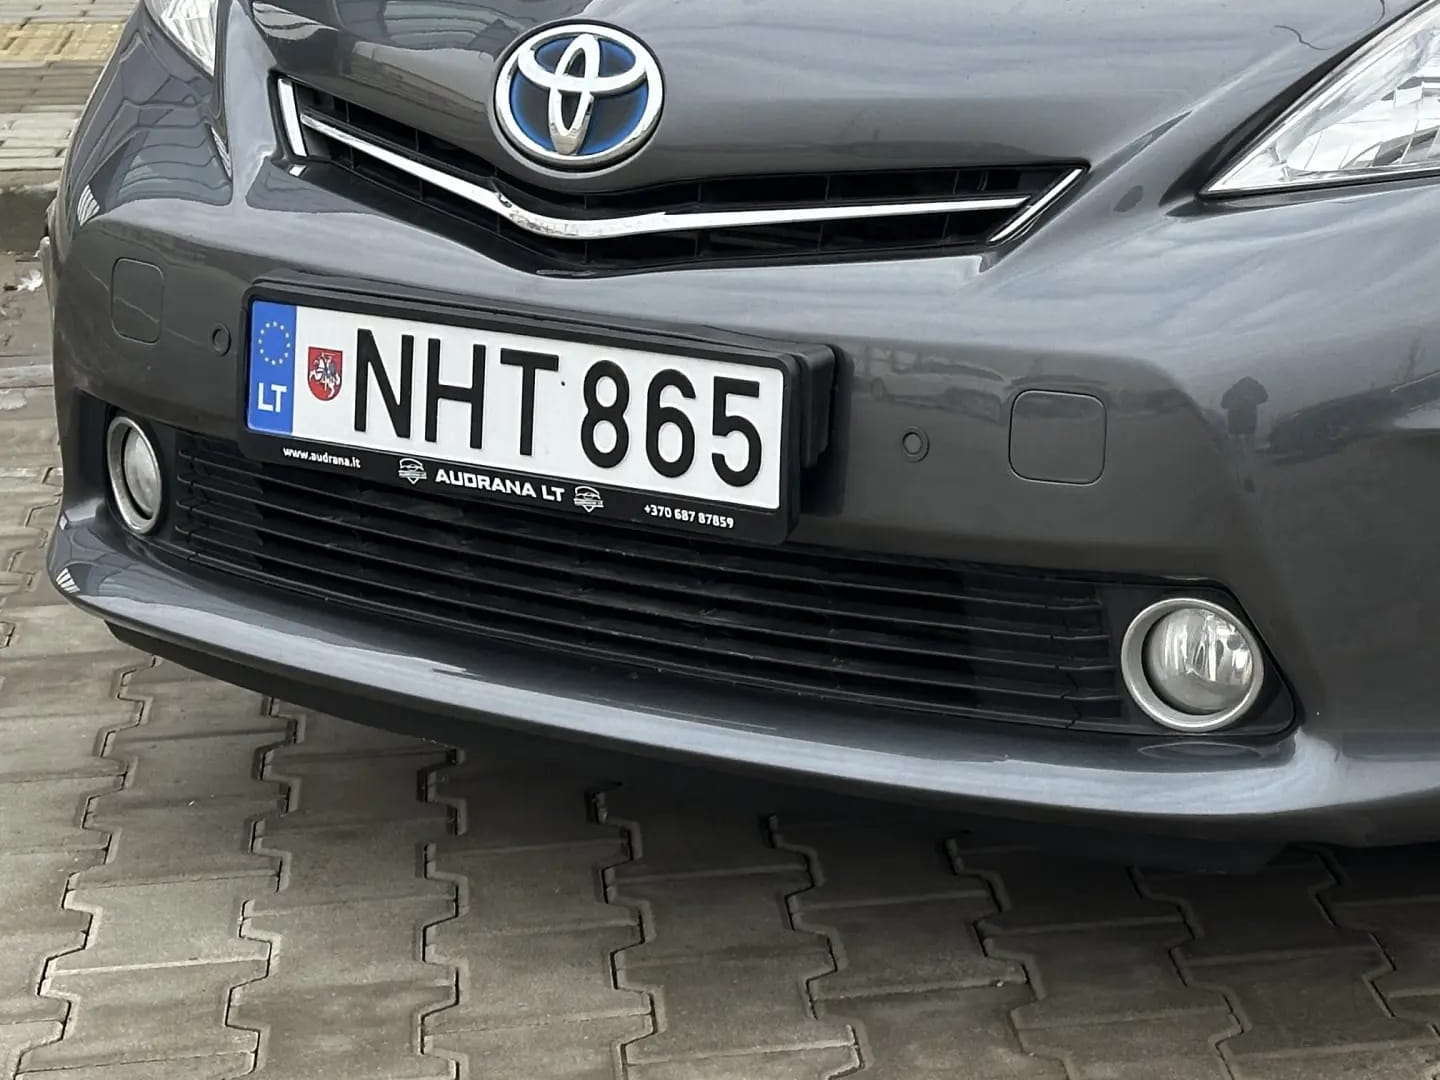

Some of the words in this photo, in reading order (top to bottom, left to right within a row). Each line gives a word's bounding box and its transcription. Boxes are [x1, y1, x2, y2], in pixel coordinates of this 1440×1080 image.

[256, 382, 288, 413] LT
[353, 328, 560, 457] NHT
[580, 360, 763, 488] 865
[435, 468, 537, 498] AUDRANA
[541, 484, 566, 502] LT
[643, 504, 672, 519] +370
[674, 508, 696, 522] 687
[698, 512, 735, 529] 87859
